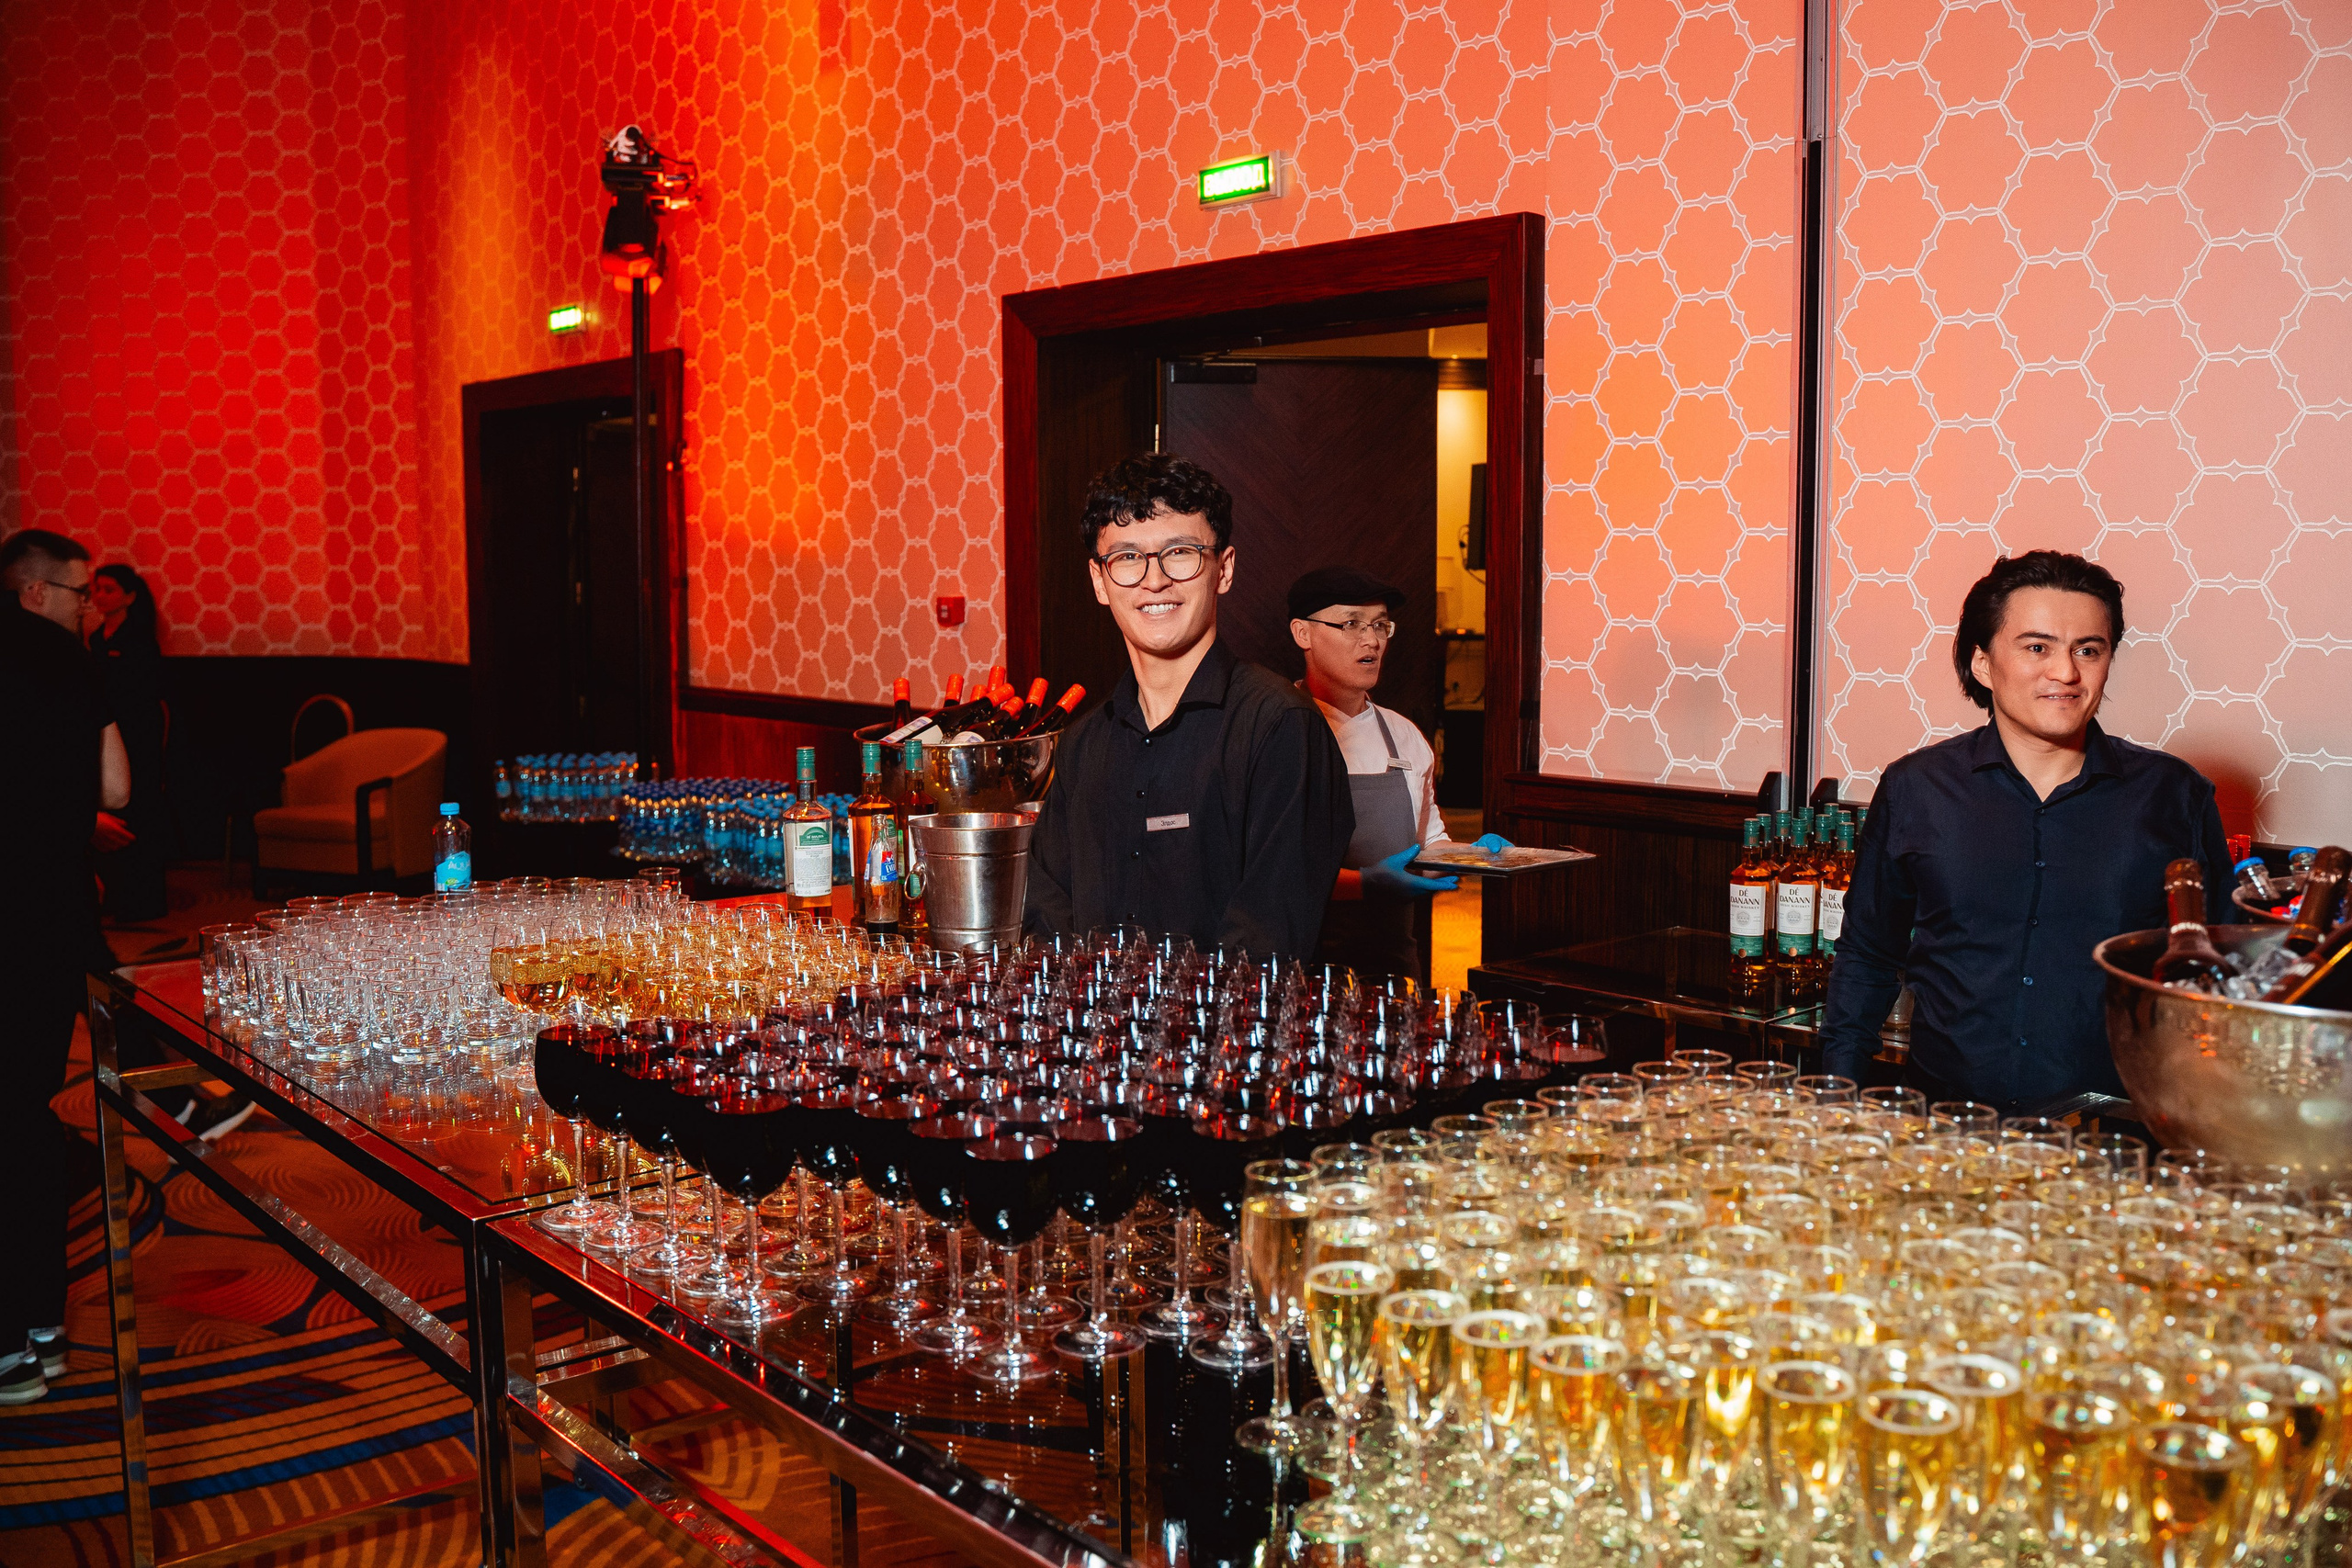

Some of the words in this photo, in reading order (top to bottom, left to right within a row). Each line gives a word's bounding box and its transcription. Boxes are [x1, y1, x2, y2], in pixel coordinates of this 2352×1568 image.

[1739, 888, 1748, 897] DÉ
[1790, 886, 1799, 896] DÉ
[1730, 896, 1759, 905] DANANN
[1780, 895, 1810, 904] DANANN
[1829, 893, 1837, 901] DÉ
